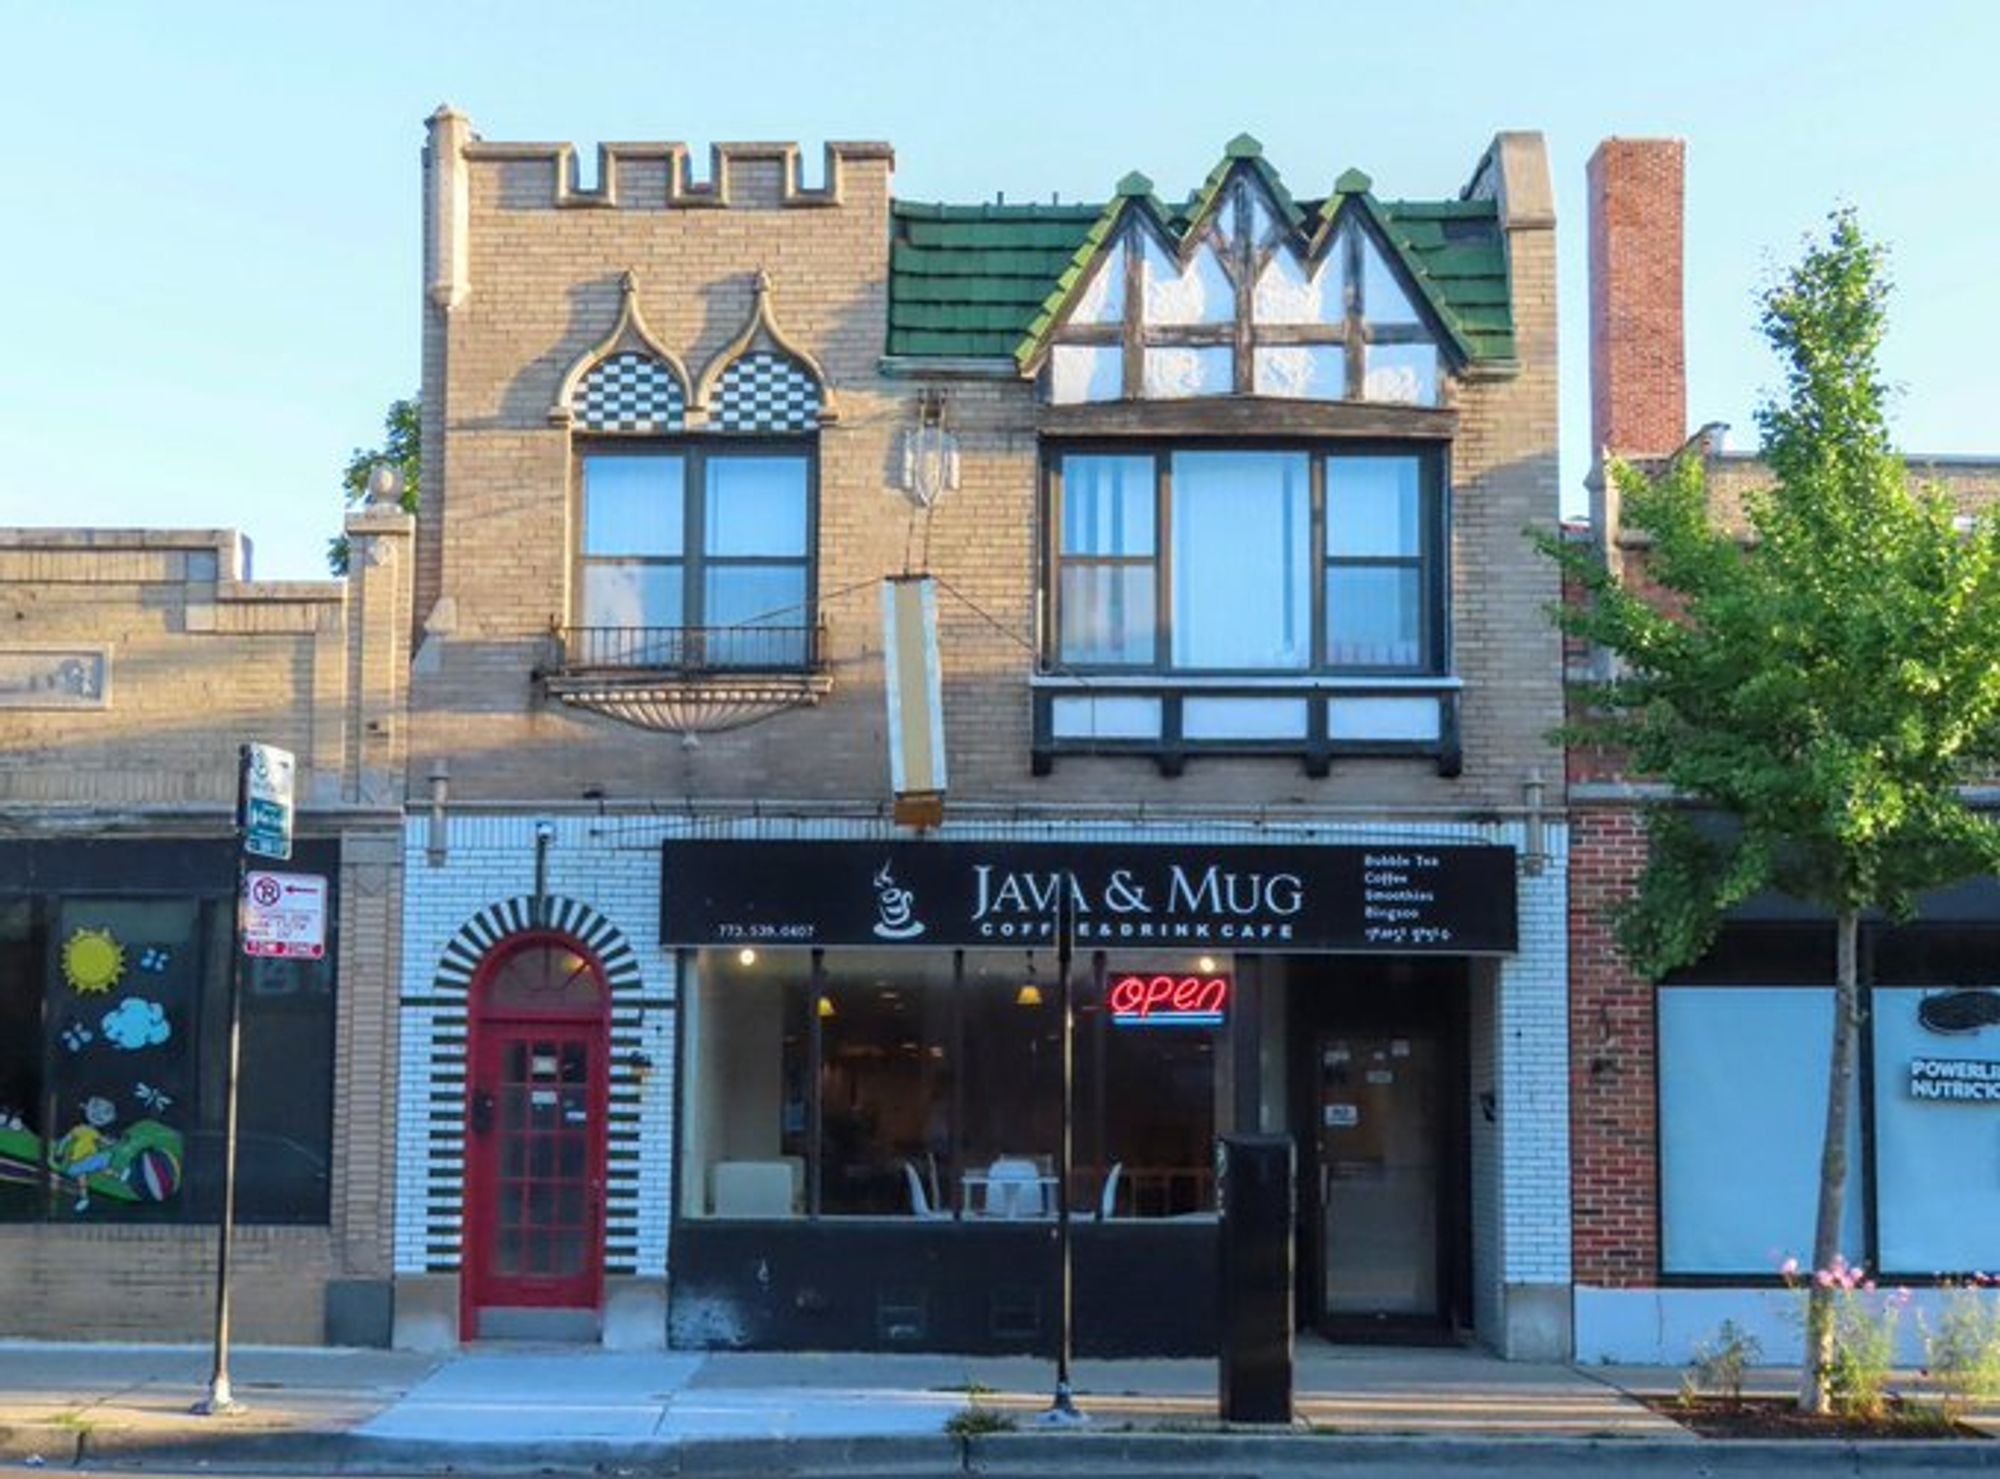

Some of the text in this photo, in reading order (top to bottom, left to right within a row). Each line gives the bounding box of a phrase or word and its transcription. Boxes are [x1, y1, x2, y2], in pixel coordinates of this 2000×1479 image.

[1364, 871, 1408, 886] Coffee
[1103, 869, 1151, 914] &
[1364, 889, 1434, 901] Smoothies
[1220, 923, 1292, 938] CAFE
